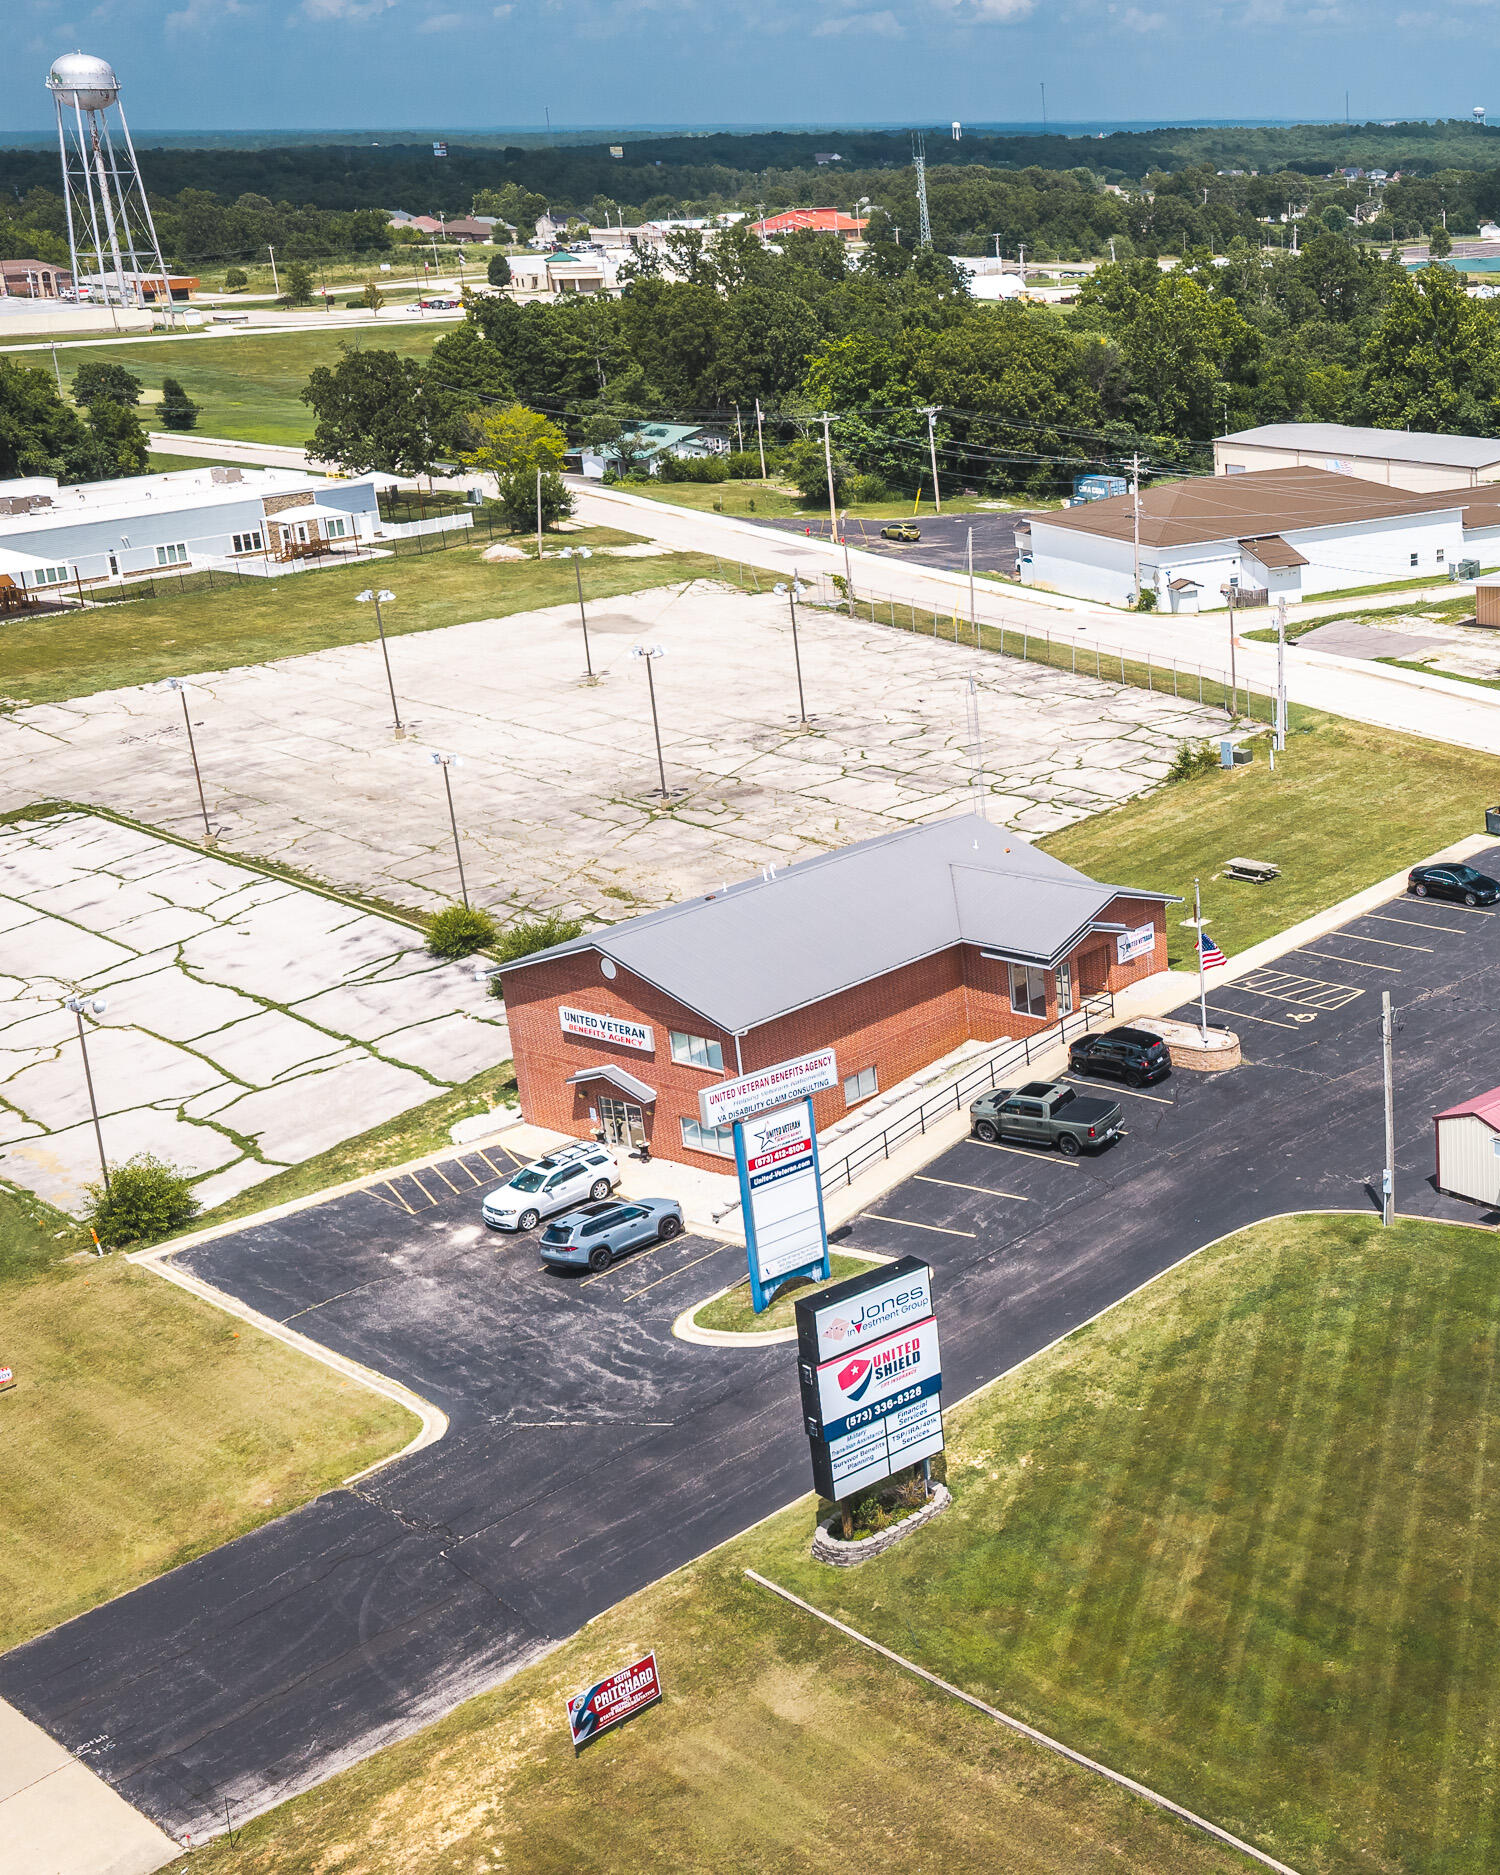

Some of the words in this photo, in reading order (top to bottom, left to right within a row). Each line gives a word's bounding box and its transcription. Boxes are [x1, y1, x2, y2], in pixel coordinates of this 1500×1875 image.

[564, 1012, 598, 1028] UNITED
[600, 1020, 645, 1039] VETERAN
[569, 1024, 606, 1038] BENEFITS
[609, 1034, 643, 1047] AGENCY
[710, 1089, 736, 1105] UNITED
[737, 1078, 770, 1096] VETERAN
[771, 1066, 804, 1085] BENEFITS
[805, 1055, 832, 1072] AGENCY
[718, 1114, 727, 1123] VA
[728, 1100, 765, 1119] DISABILITY
[766, 1093, 787, 1106] CLAIM
[788, 1079, 829, 1098] CONSULTING
[852, 1287, 923, 1325] Jones
[901, 1297, 928, 1314] Group
[873, 1338, 920, 1368] UNITED
[875, 1350, 920, 1380] SHIELD
[846, 1409, 872, 1430] (573)
[874, 1386, 922, 1415] 336-8328
[897, 1400, 928, 1419] Financial
[898, 1409, 927, 1426] Services
[902, 1429, 930, 1444] Services
[833, 1454, 859, 1470] Survivor
[860, 1442, 885, 1456] Benefits
[847, 1455, 874, 1470] Planning
[594, 1667, 653, 1709] PRITCHARD
